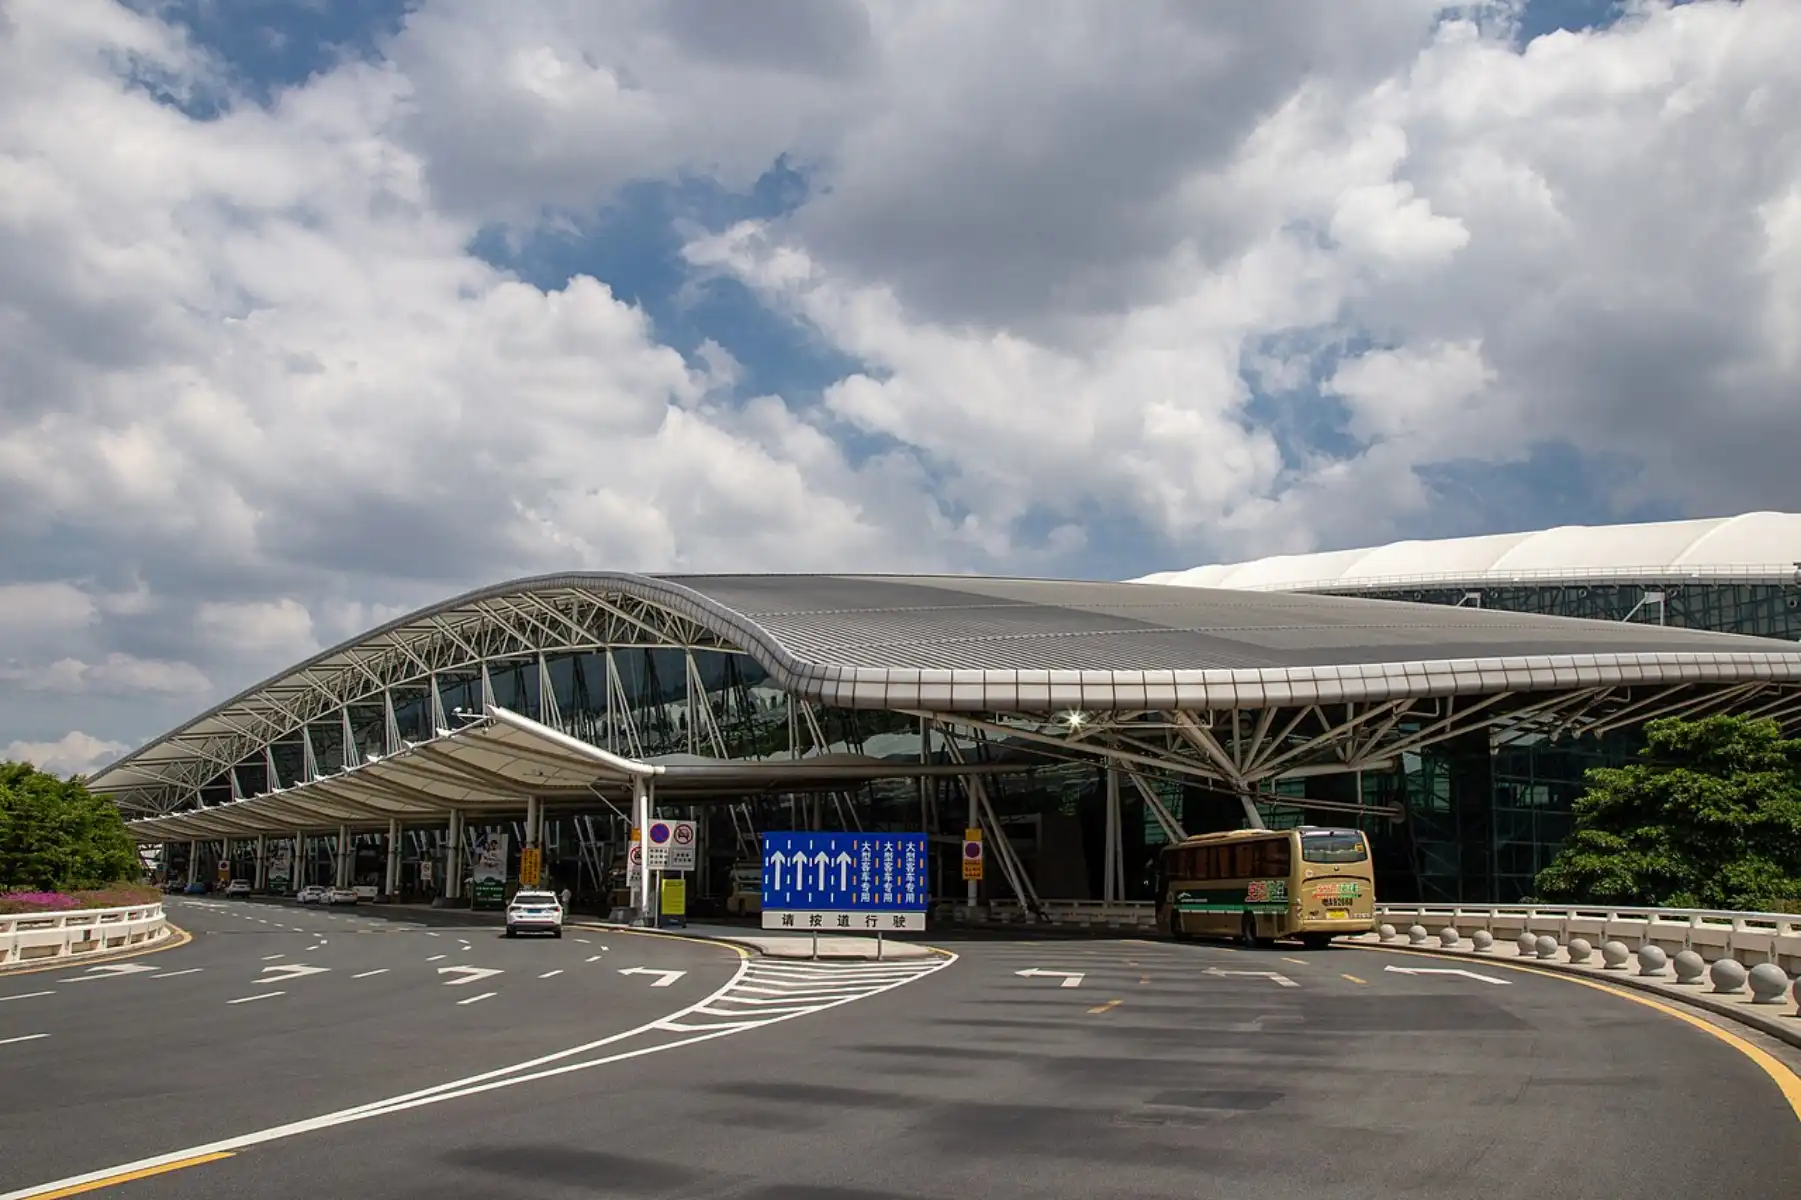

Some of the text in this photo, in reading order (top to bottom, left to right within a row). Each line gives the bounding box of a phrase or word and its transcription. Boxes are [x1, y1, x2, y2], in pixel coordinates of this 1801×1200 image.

[860, 840, 871, 903] 大型客车专用
[883, 841, 894, 903] 大型客车专用
[905, 841, 916, 903] 大型客车专用
[781, 913, 906, 928] 请按道行驶
